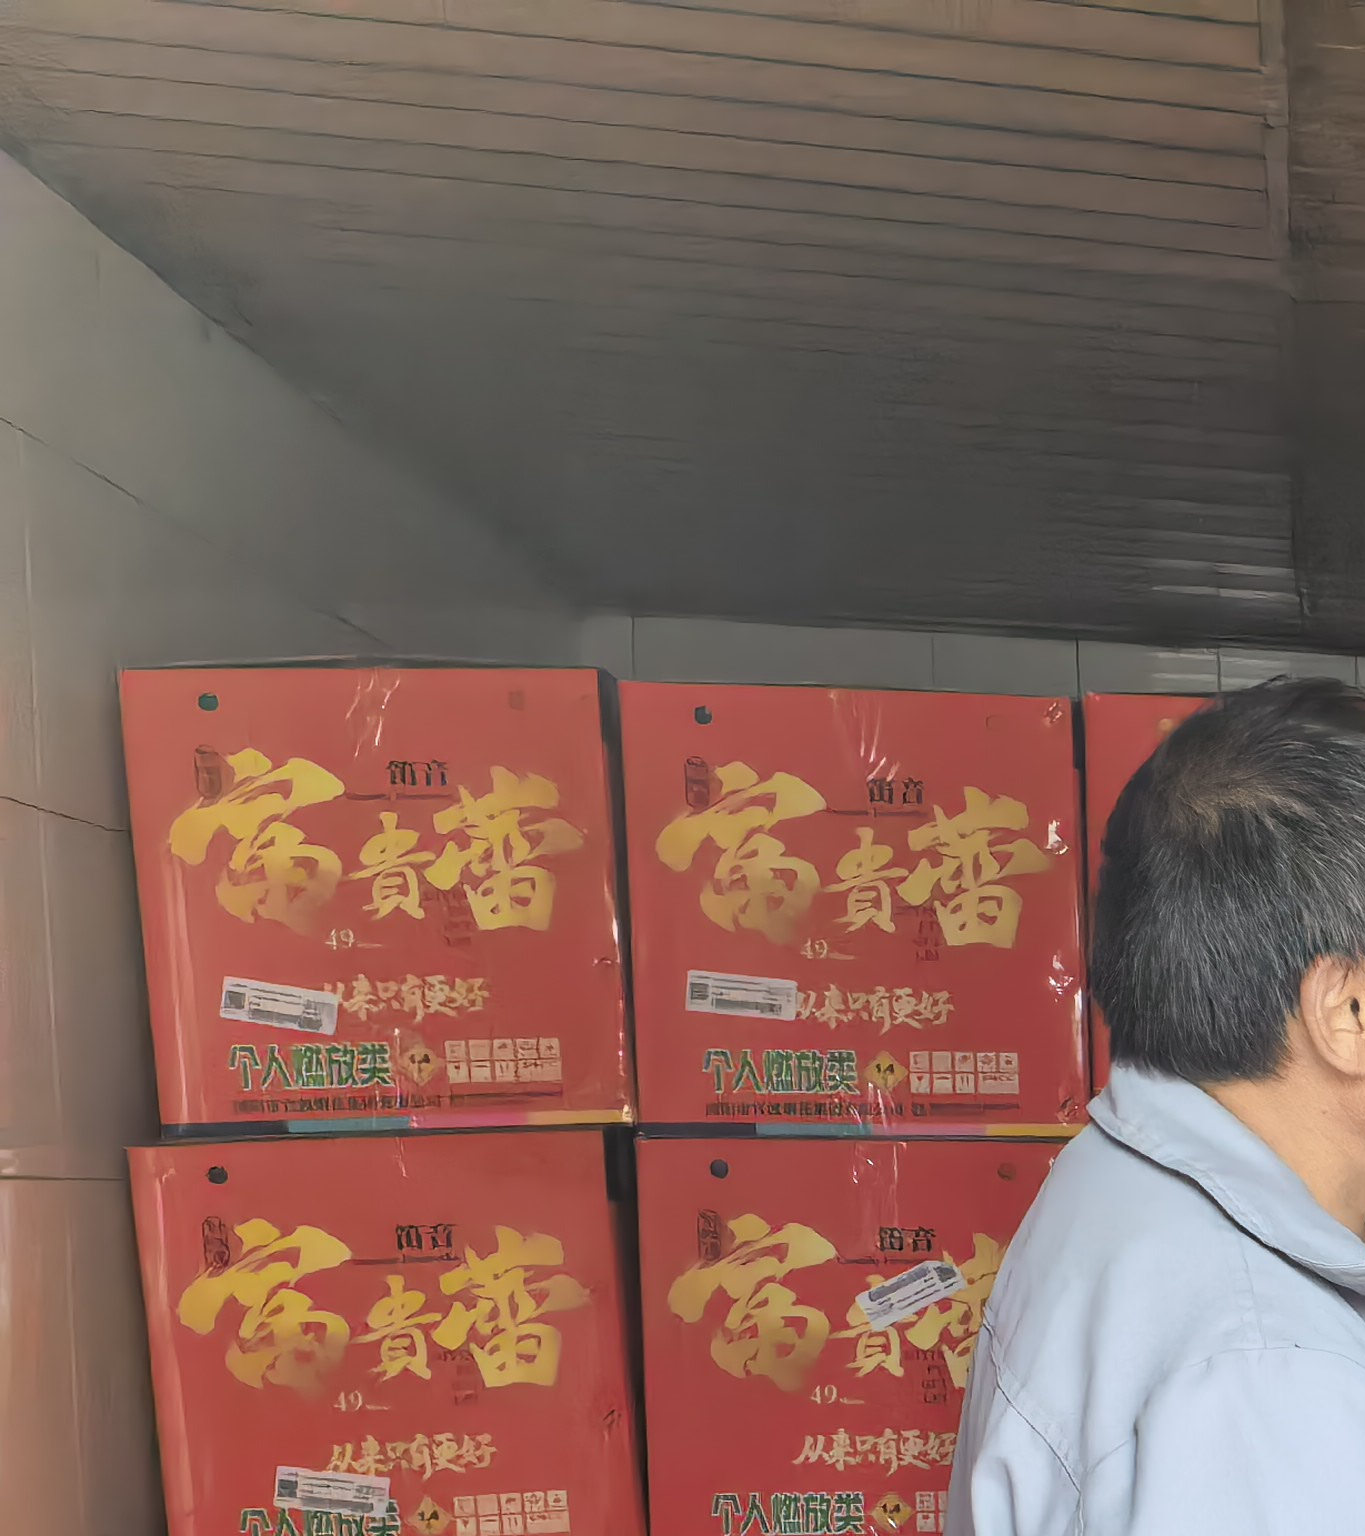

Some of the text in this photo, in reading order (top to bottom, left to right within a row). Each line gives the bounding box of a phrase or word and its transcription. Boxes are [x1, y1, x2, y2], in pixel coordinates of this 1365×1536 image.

[792, 1428, 957, 1476] 从来只有更好
